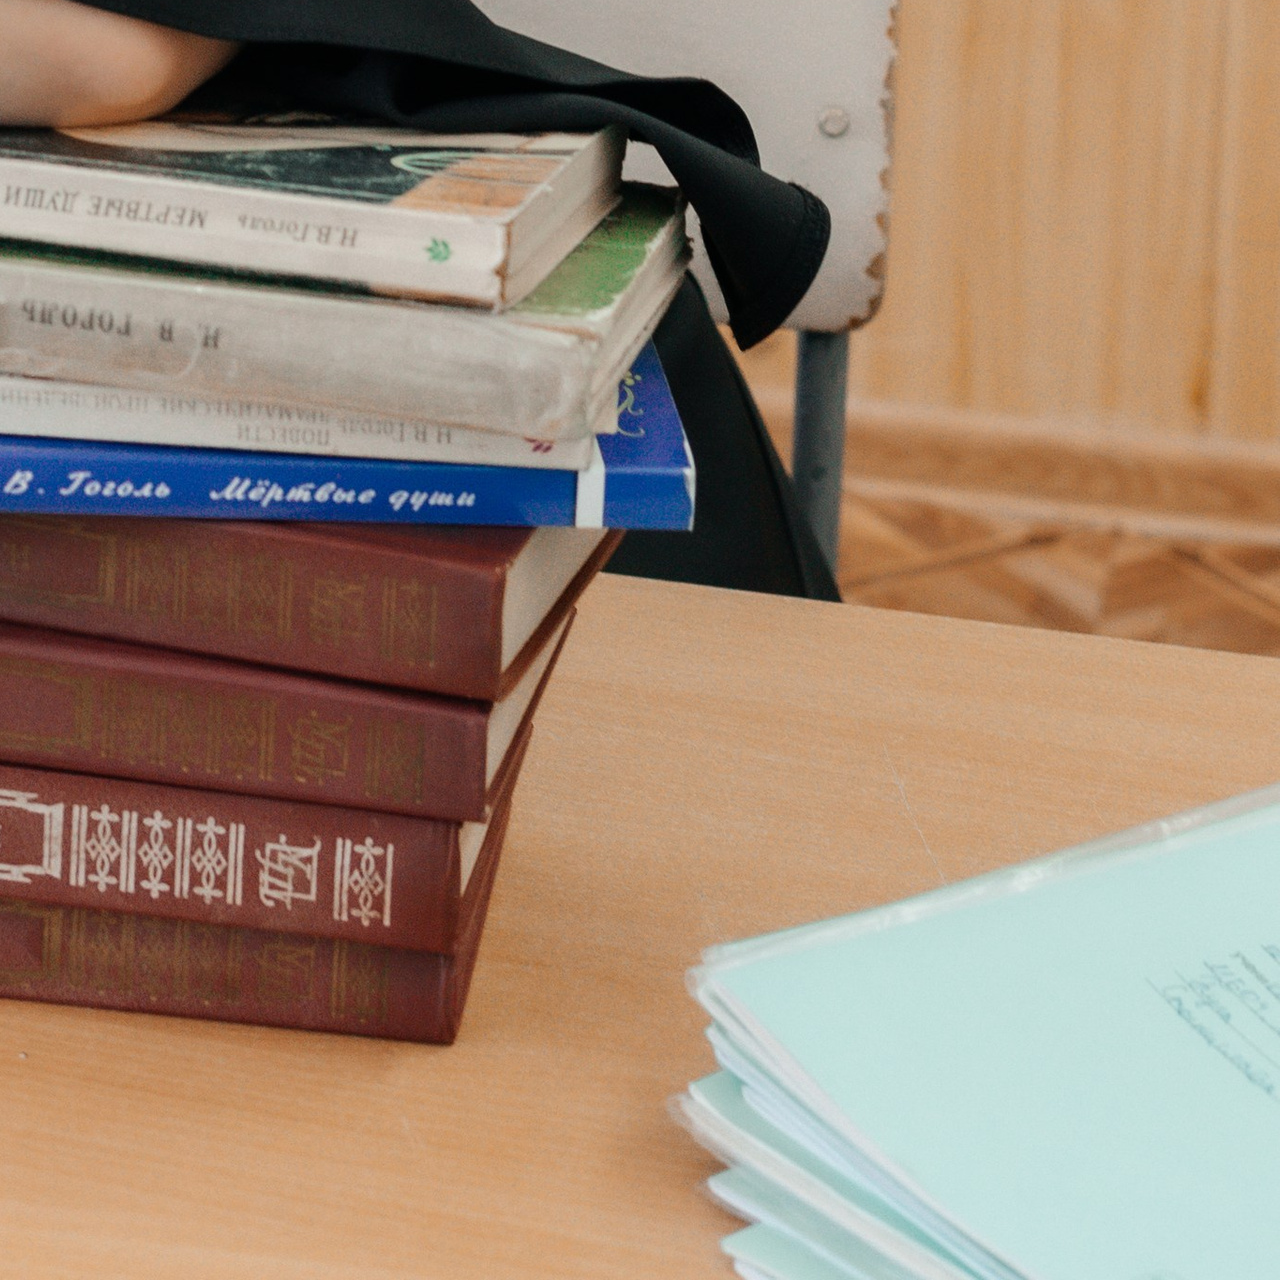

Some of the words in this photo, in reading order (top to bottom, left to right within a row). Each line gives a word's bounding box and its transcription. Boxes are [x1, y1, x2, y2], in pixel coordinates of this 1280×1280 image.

[3, 184, 80, 214] ДУШИ
[86, 195, 209, 229] МЕРТВЫЕ
[22, 299, 133, 338] ГОГОЛЬ
[58, 470, 172, 499] Гоголь
[208, 475, 378, 509] Мёртвые
[388, 488, 477, 514] души
